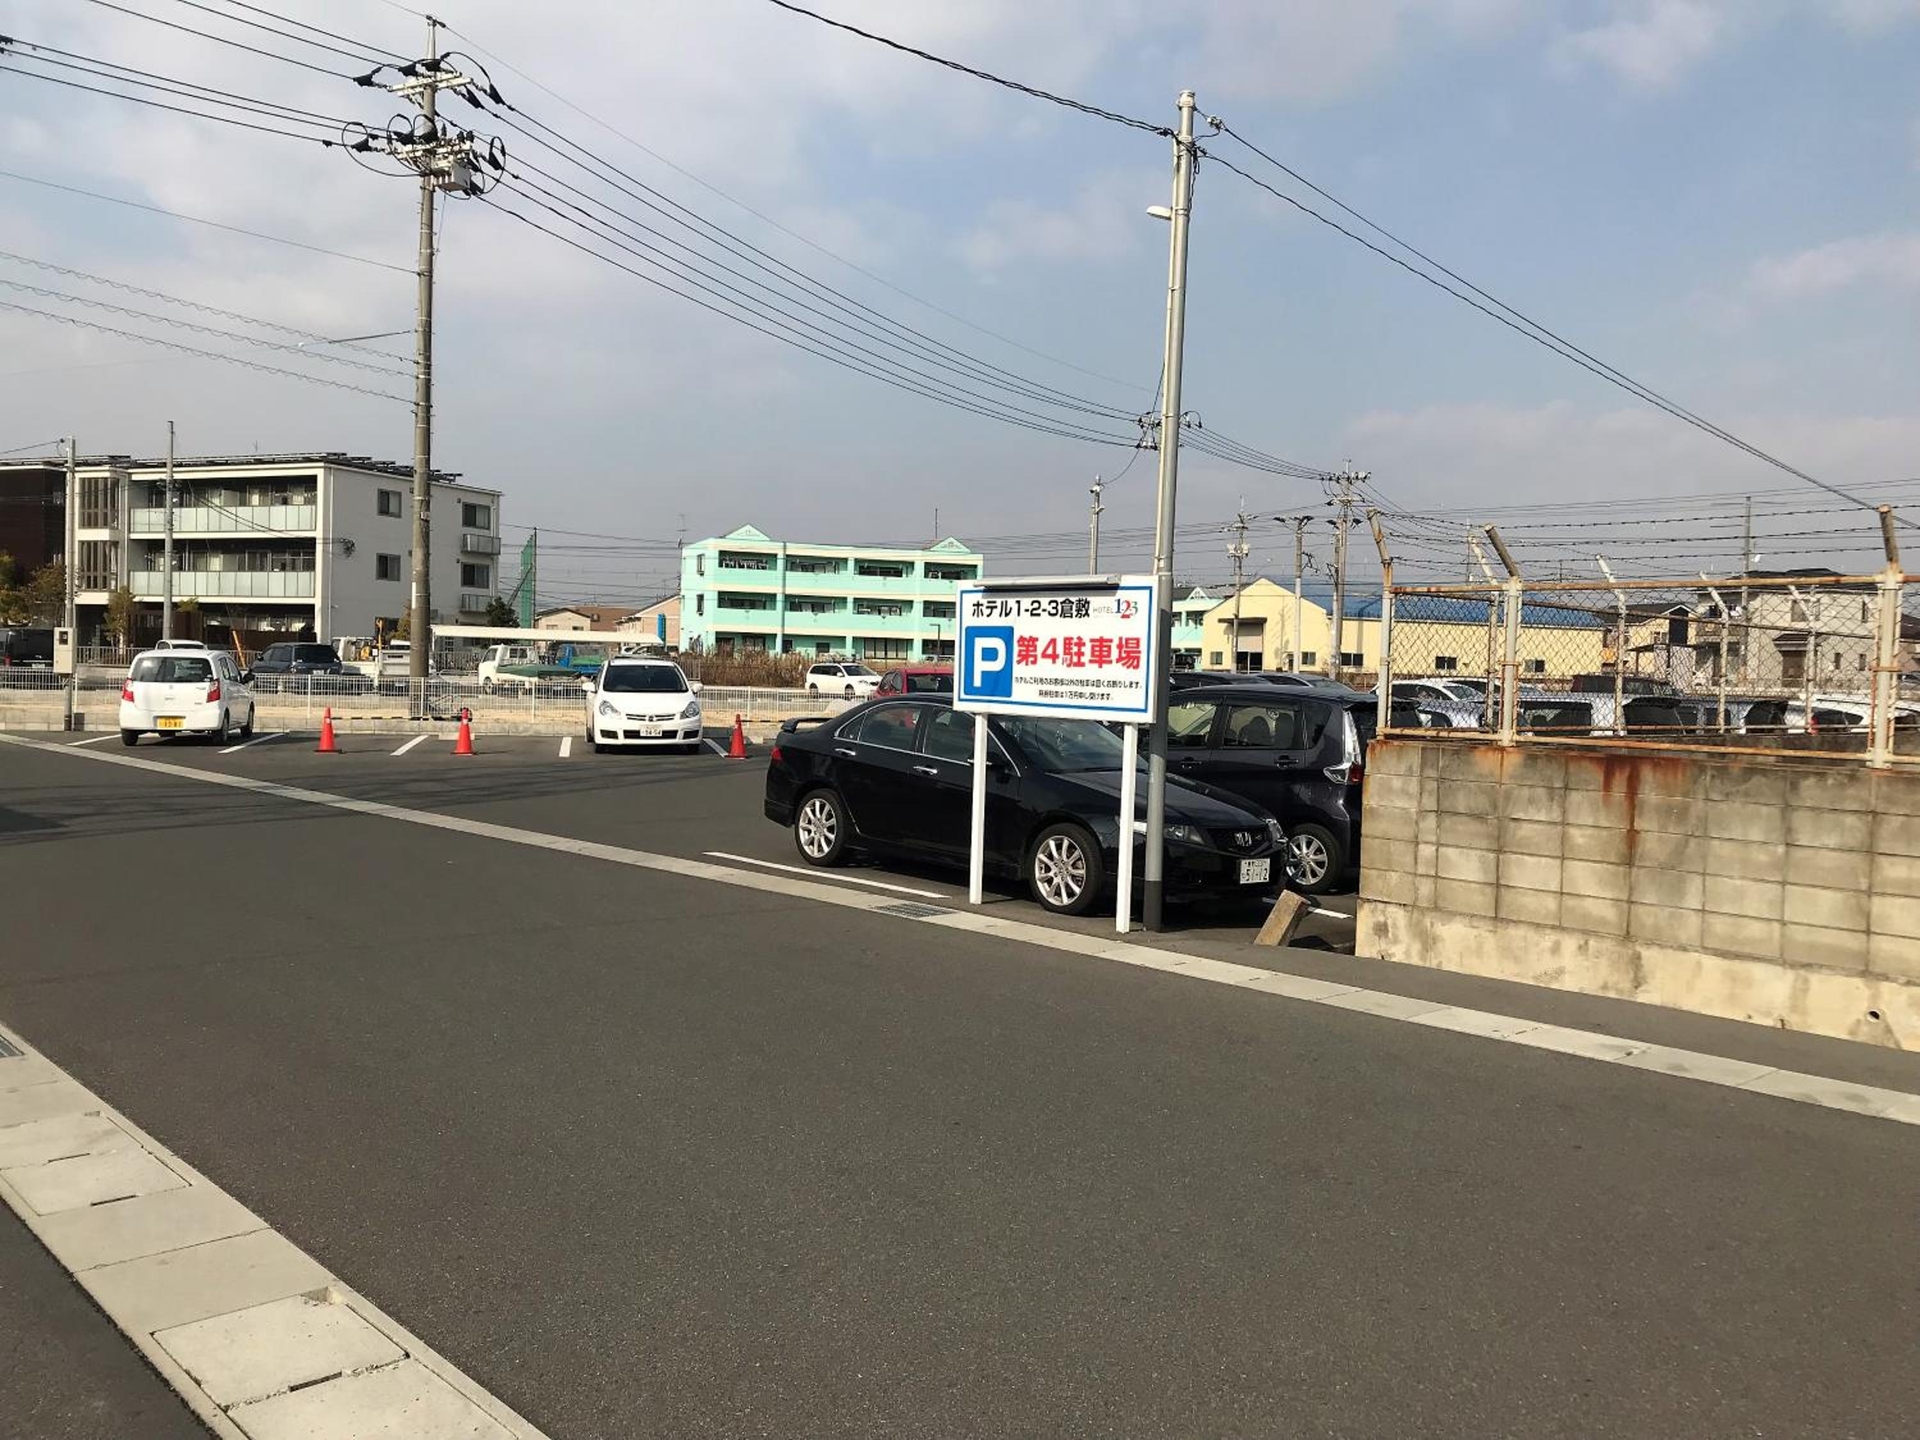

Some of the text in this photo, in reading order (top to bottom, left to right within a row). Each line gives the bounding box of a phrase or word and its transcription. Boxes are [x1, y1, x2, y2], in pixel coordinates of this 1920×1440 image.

[972, 599, 1090, 618] ホテル1-2-3倉敷
[973, 638, 1006, 687] P
[1016, 636, 1141, 669] 第4駐車場
